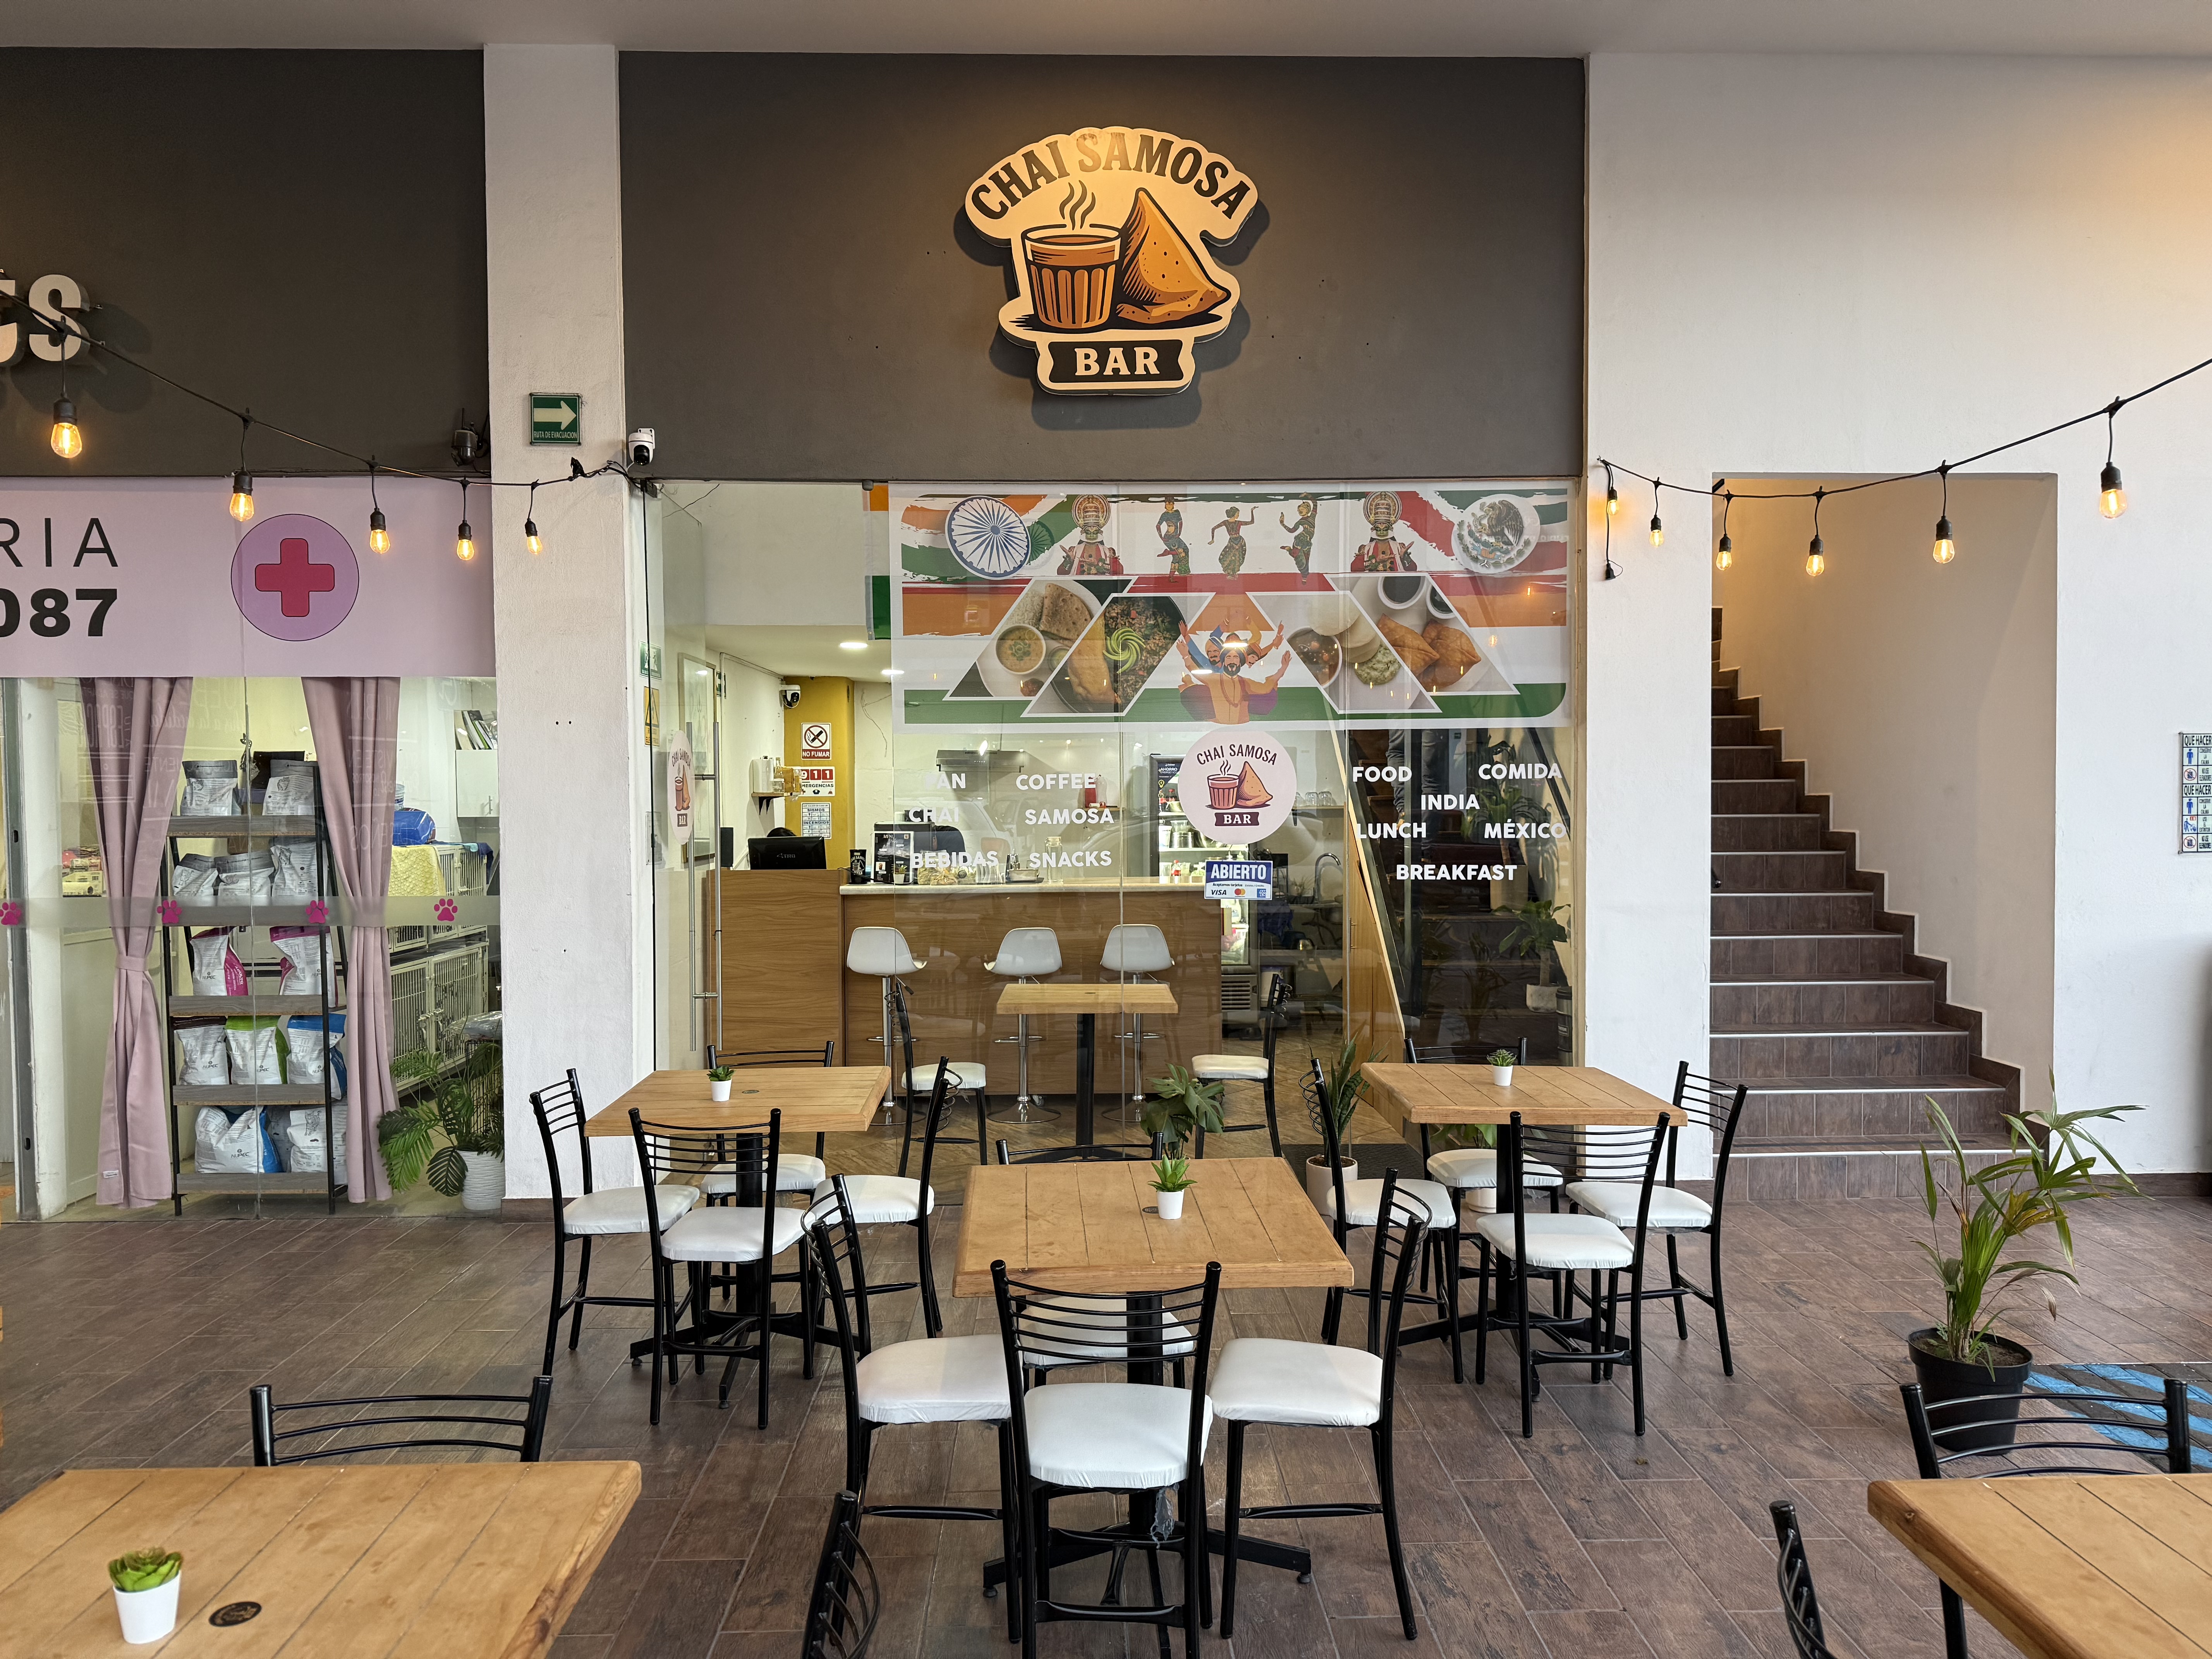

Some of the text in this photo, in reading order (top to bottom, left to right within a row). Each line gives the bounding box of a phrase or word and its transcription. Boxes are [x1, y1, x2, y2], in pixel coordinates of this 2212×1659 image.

[971, 132, 1250, 220] CHAI SAMOSA
[1075, 347, 1160, 376] BAR
[2185, 735, 2212, 746] QUE HACER
[1197, 744, 1278, 766] CHAI SAMOSA
[1353, 766, 1412, 782] FOOD
[1478, 763, 1563, 780] COMIDA
[1016, 773, 1096, 790] COFFEE
[2184, 785, 2211, 796] QUE HACER
[1421, 794, 1480, 810] INDIA
[909, 807, 959, 823] CHAI
[1025, 808, 1115, 826] SAMOSA
[1223, 814, 1251, 824] BAR
[1357, 822, 1427, 838] LUNCH
[1484, 819, 1567, 839] MÉXICO
[910, 850, 999, 868] BEBIDAS
[1029, 850, 1113, 868] SNACKS
[1211, 864, 1266, 880] ABIERTO
[1396, 864, 1517, 881] BREAKFAST
